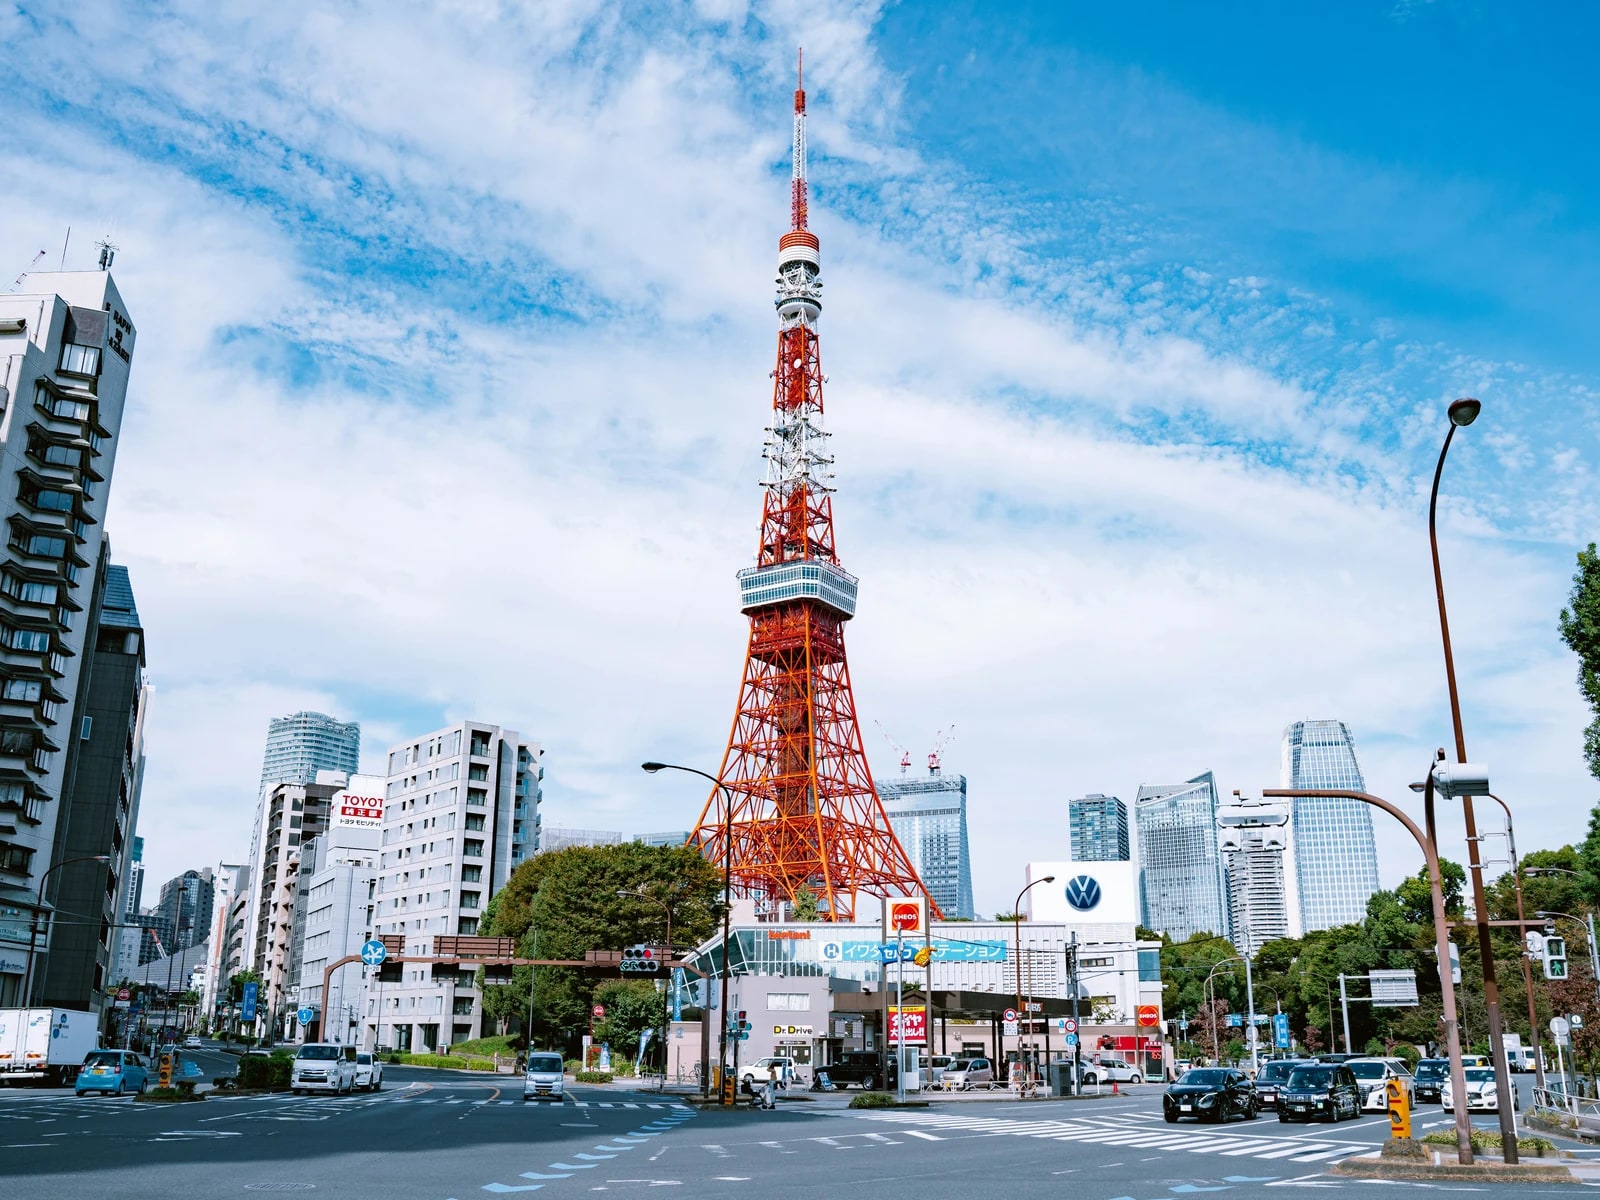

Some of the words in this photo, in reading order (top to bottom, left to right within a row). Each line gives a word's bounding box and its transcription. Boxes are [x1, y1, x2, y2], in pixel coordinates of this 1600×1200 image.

[342, 795, 383, 808] TOYOT
[773, 1025, 787, 1035] Dr.
[788, 1025, 813, 1035] Drive
[890, 1027, 925, 1037] 大出し!!
